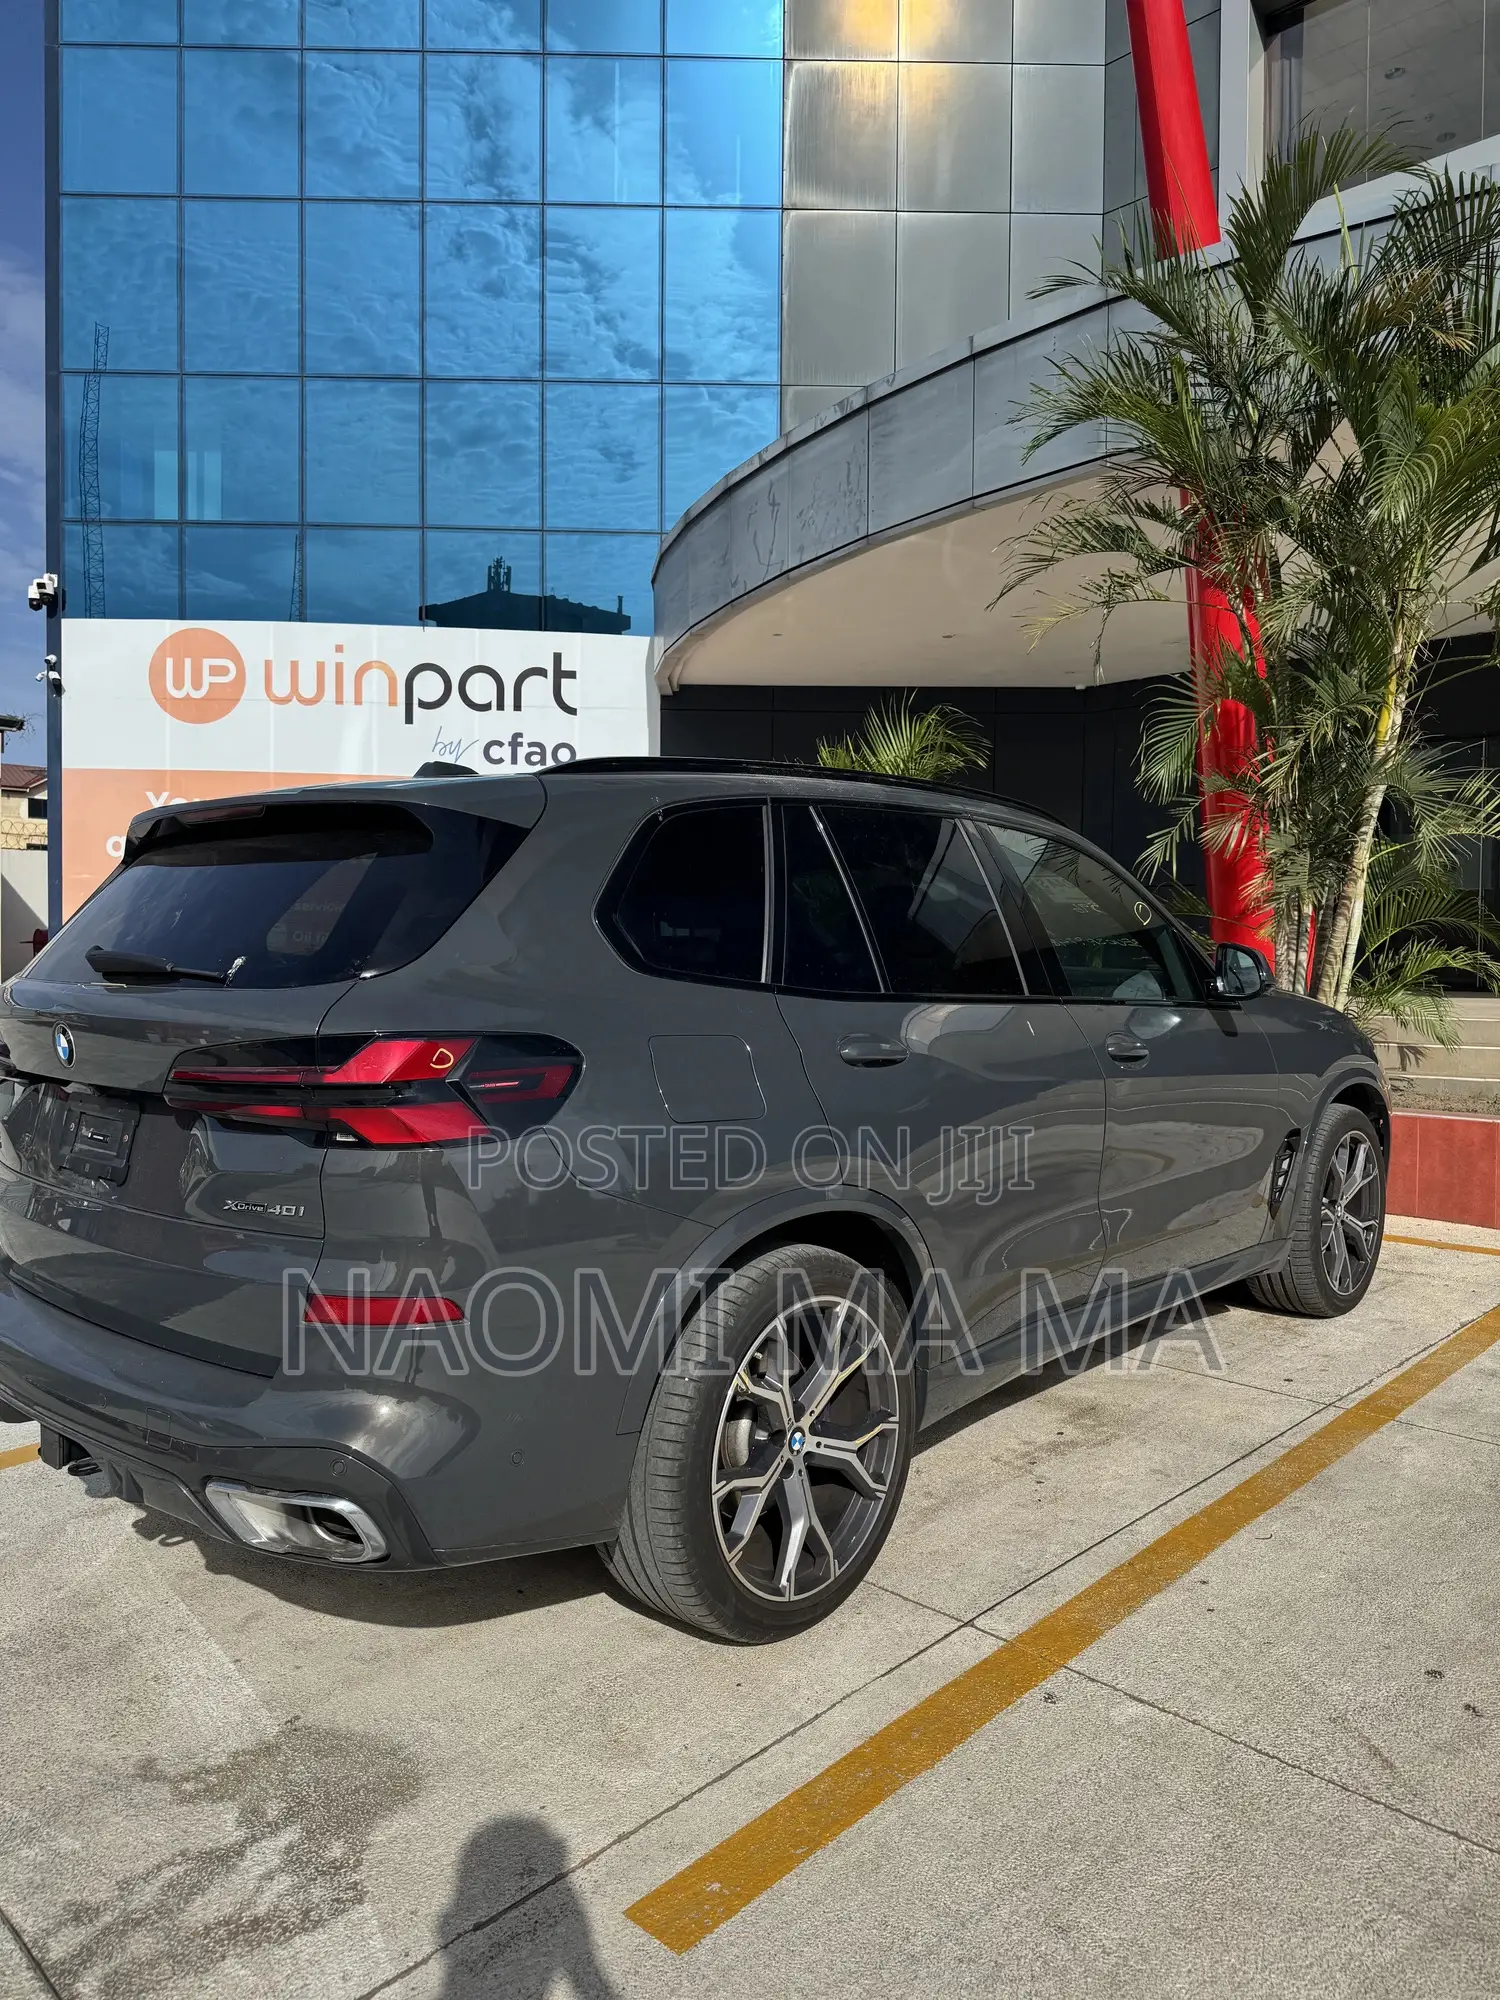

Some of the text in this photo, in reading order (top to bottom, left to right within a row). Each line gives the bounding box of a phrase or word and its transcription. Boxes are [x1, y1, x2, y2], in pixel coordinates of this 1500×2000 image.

[165, 644, 578, 725] WP winpart
[432, 726, 577, 767] by cfao
